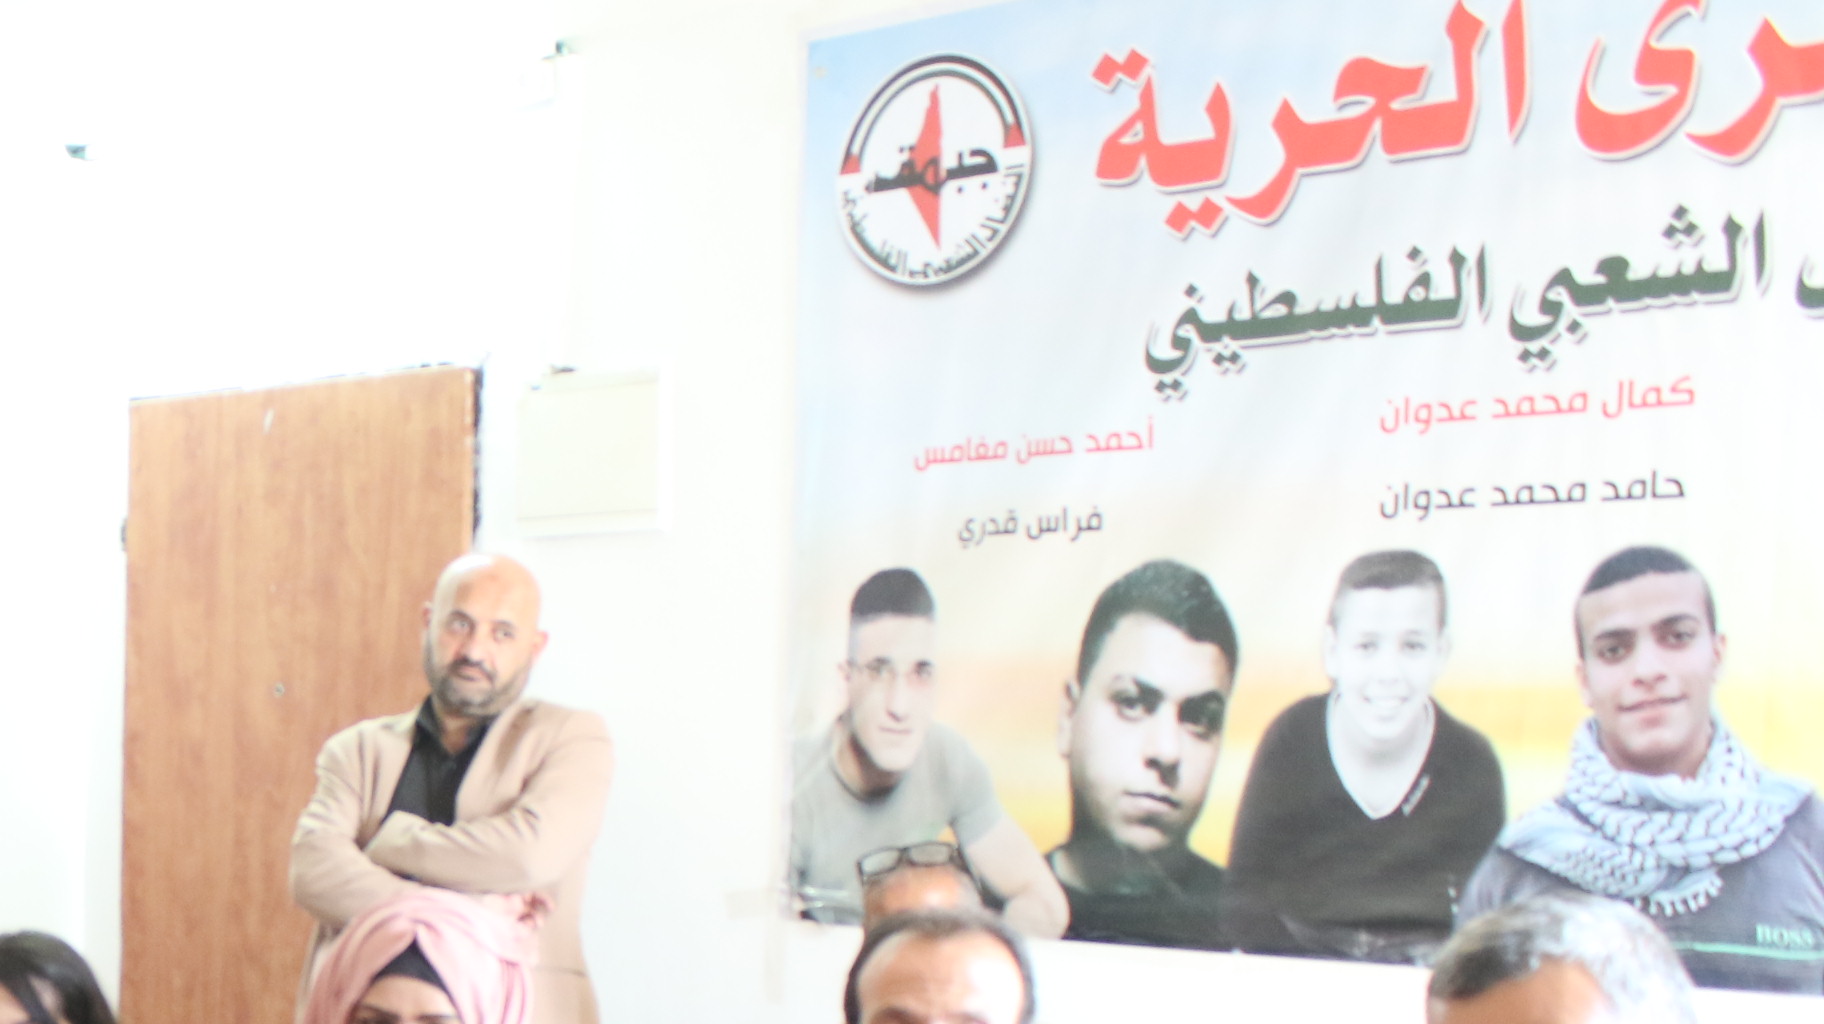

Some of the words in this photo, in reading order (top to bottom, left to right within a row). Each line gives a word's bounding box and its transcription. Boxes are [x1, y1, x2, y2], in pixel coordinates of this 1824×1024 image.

[1093, 0, 1526, 237] الحرية
[1508, 204, 1766, 369] الشعبي
[1145, 242, 1487, 400] الفلسطيني
[1380, 397, 1477, 435] عدوان
[1492, 391, 1588, 419] محمد
[1601, 375, 1695, 419] كمال
[1016, 435, 1074, 464] حسن
[1085, 415, 1154, 453] أحمد
[914, 436, 1008, 472] مغامس
[1380, 482, 1475, 522] عدوان
[1491, 482, 1587, 507] محمد
[1600, 469, 1685, 502] حامد
[957, 508, 1018, 549] قدري
[1026, 505, 1103, 542] فراس
[1756, 923, 1814, 948] BOSS
